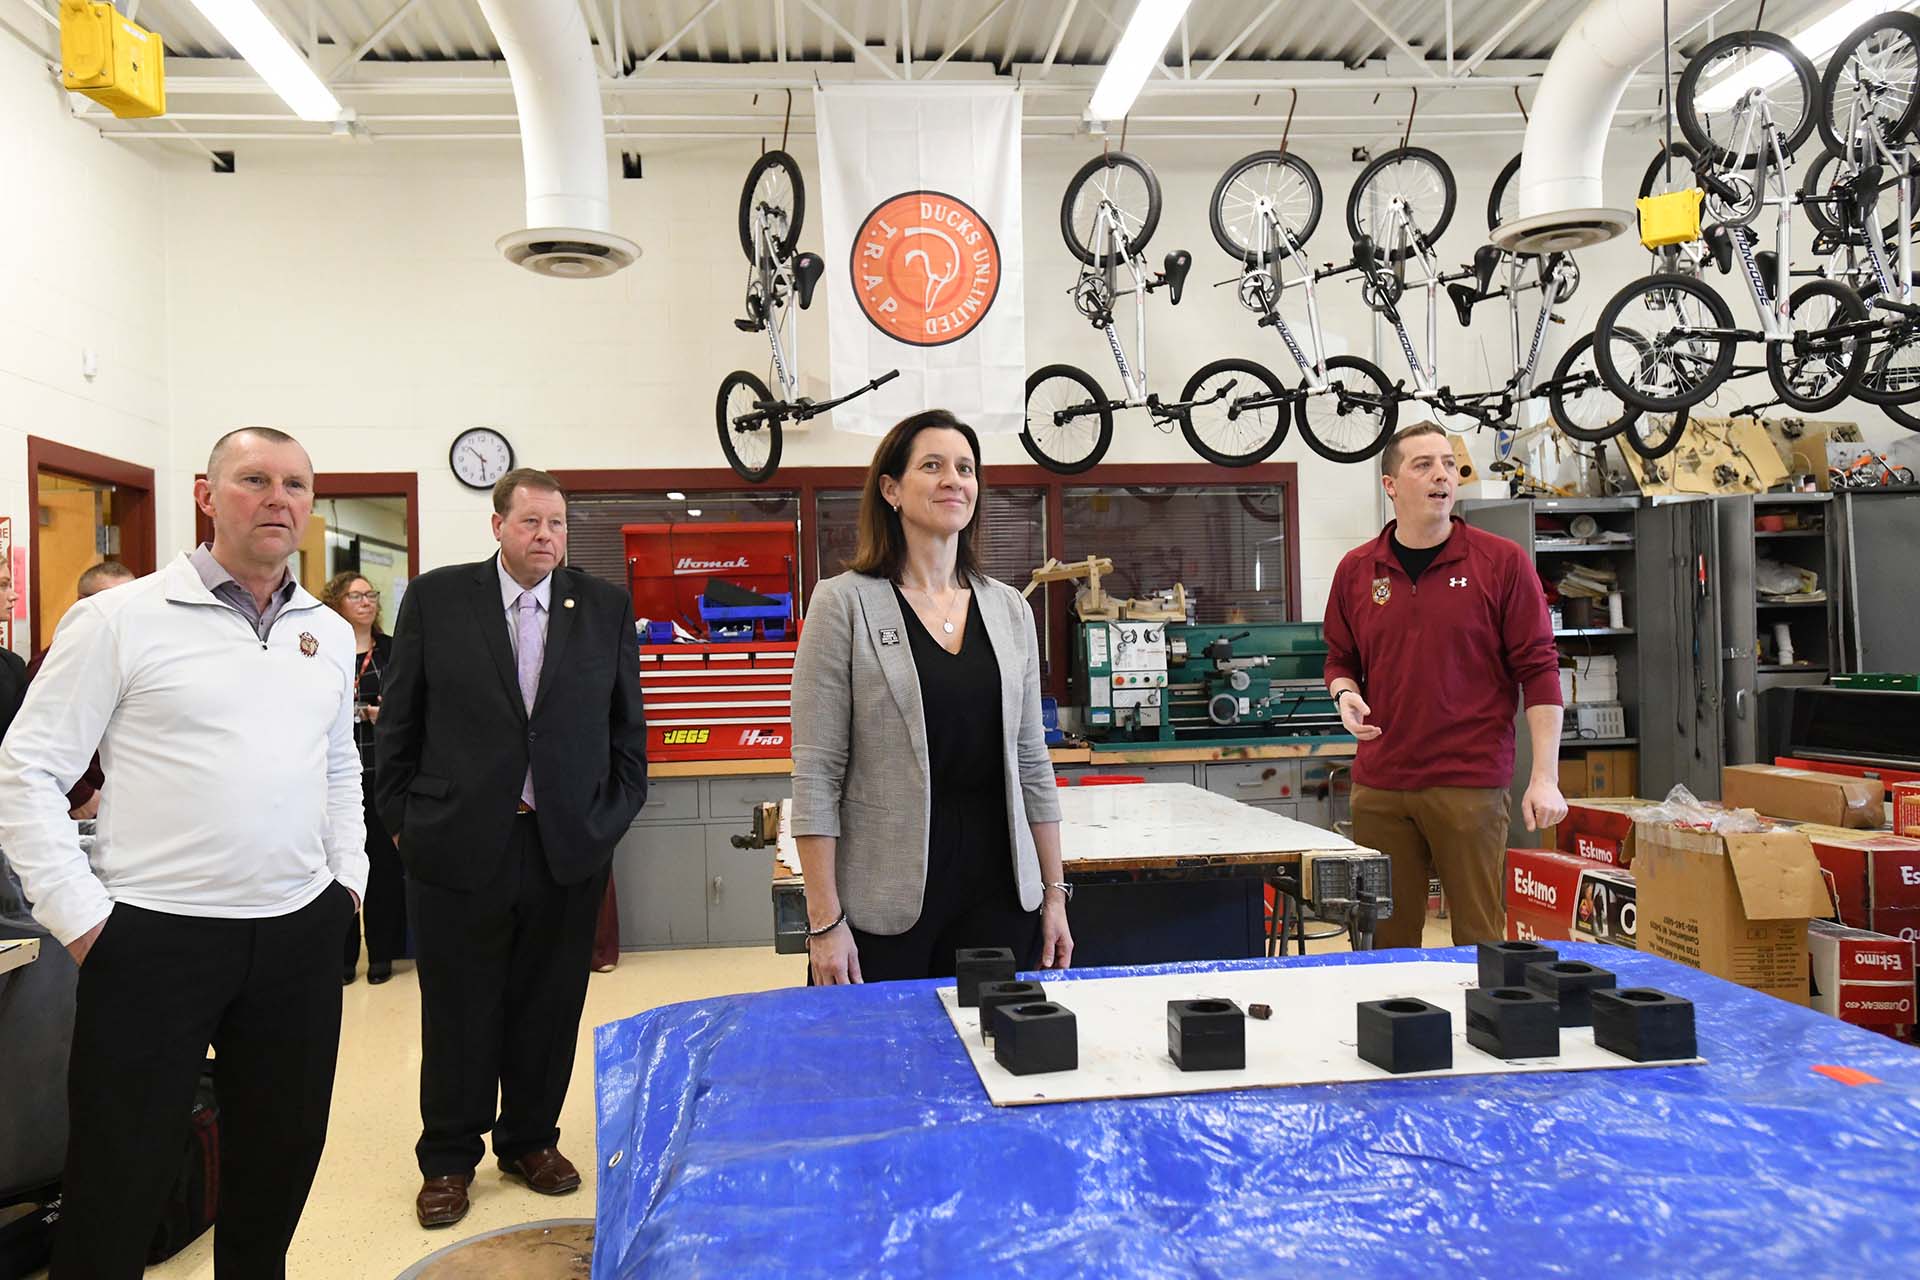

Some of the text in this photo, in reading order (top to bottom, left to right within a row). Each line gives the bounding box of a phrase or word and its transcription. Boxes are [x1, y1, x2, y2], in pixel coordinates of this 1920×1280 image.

[920, 202, 991, 335] DUCKS UNLIMITED
[1734, 227, 1770, 306] MONGOOSE
[1274, 320, 1309, 368] ONGOOSE
[1396, 322, 1420, 371] ONGOOSE
[676, 557, 750, 571] Homak
[664, 729, 710, 745] JEGS
[1578, 839, 1613, 864] Eskimo
[1514, 867, 1557, 905] Eskimo
[1855, 953, 1903, 971] Eskimo
